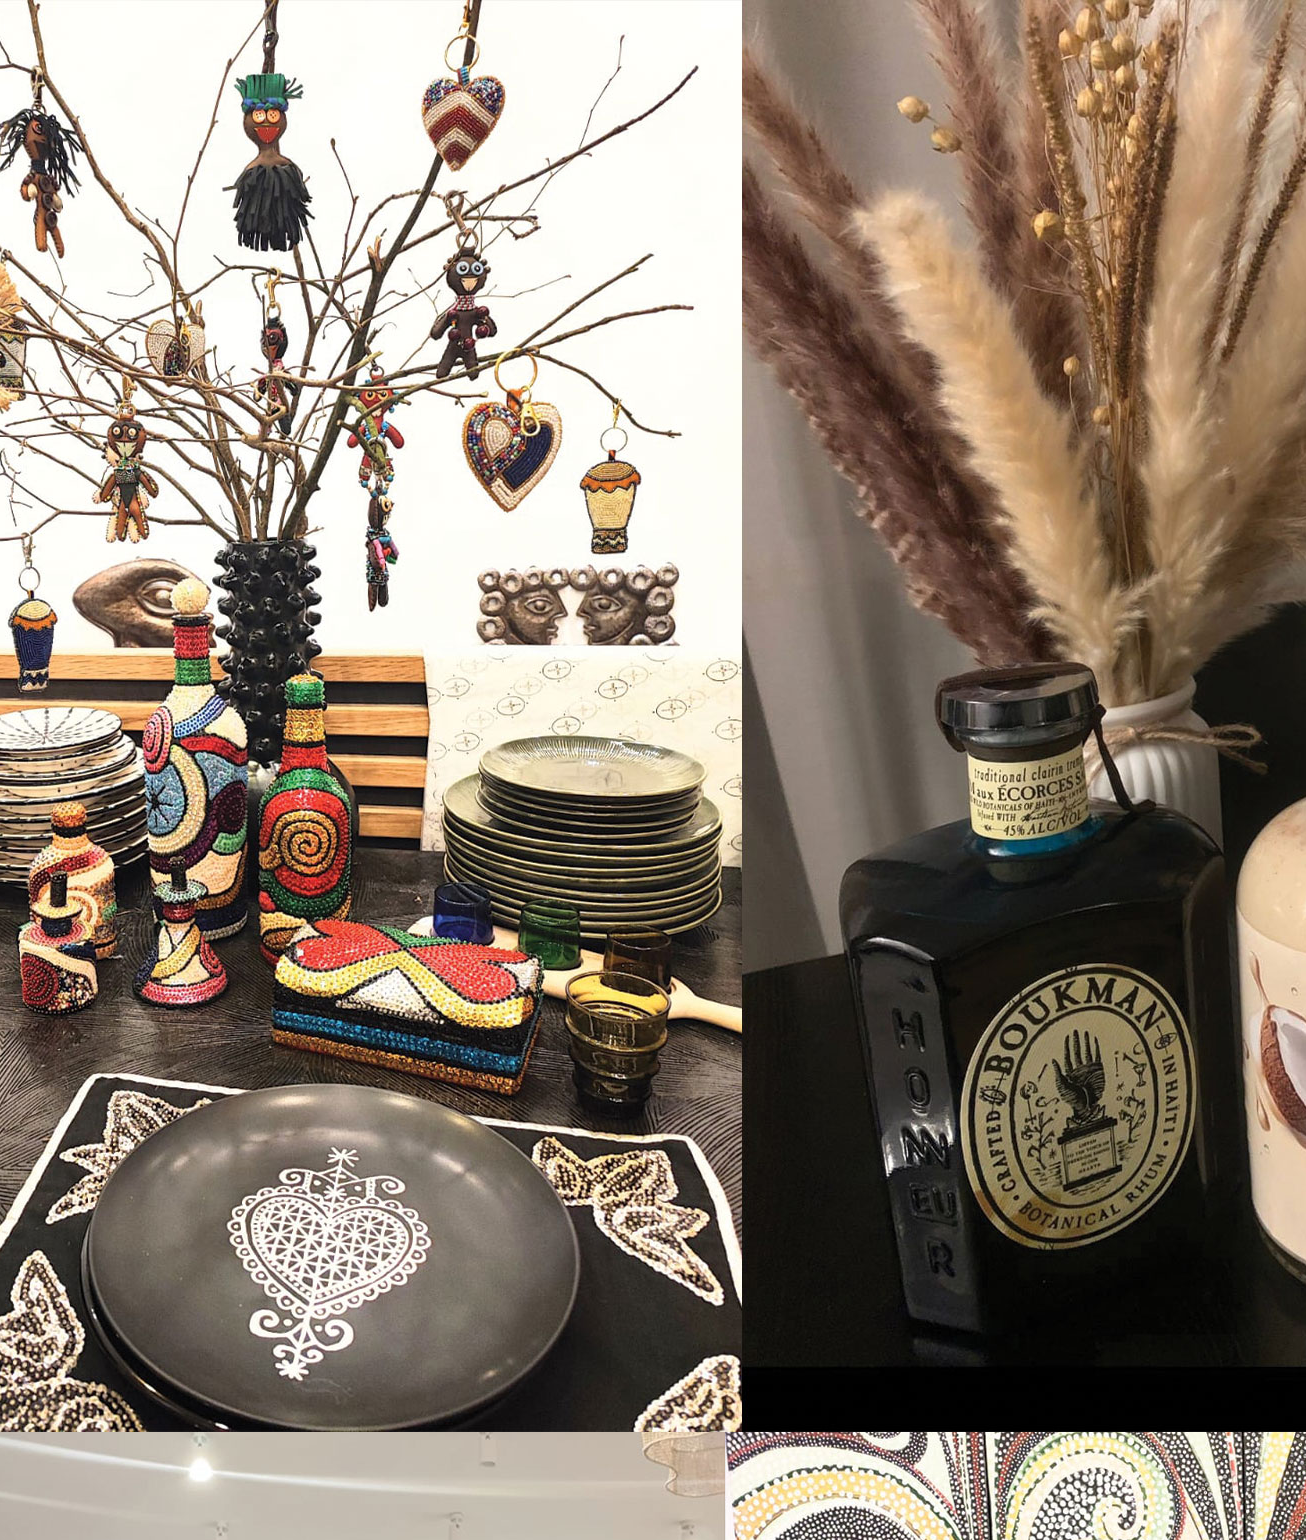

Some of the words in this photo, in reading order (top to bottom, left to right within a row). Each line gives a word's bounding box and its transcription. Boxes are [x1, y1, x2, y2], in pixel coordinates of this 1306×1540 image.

[974, 767, 1027, 783] traditional
[1031, 764, 1064, 782] clairin
[997, 775, 1073, 801] ÉCORCES
[1003, 825, 1025, 837] 45%
[984, 976, 1166, 1076] BOUKMAN
[985, 1110, 1018, 1193] CRAFTED
[1161, 1054, 1177, 1076] IN
[1018, 1200, 1122, 1231] BOTANICAL
[1124, 1152, 1168, 1204] RHUM
